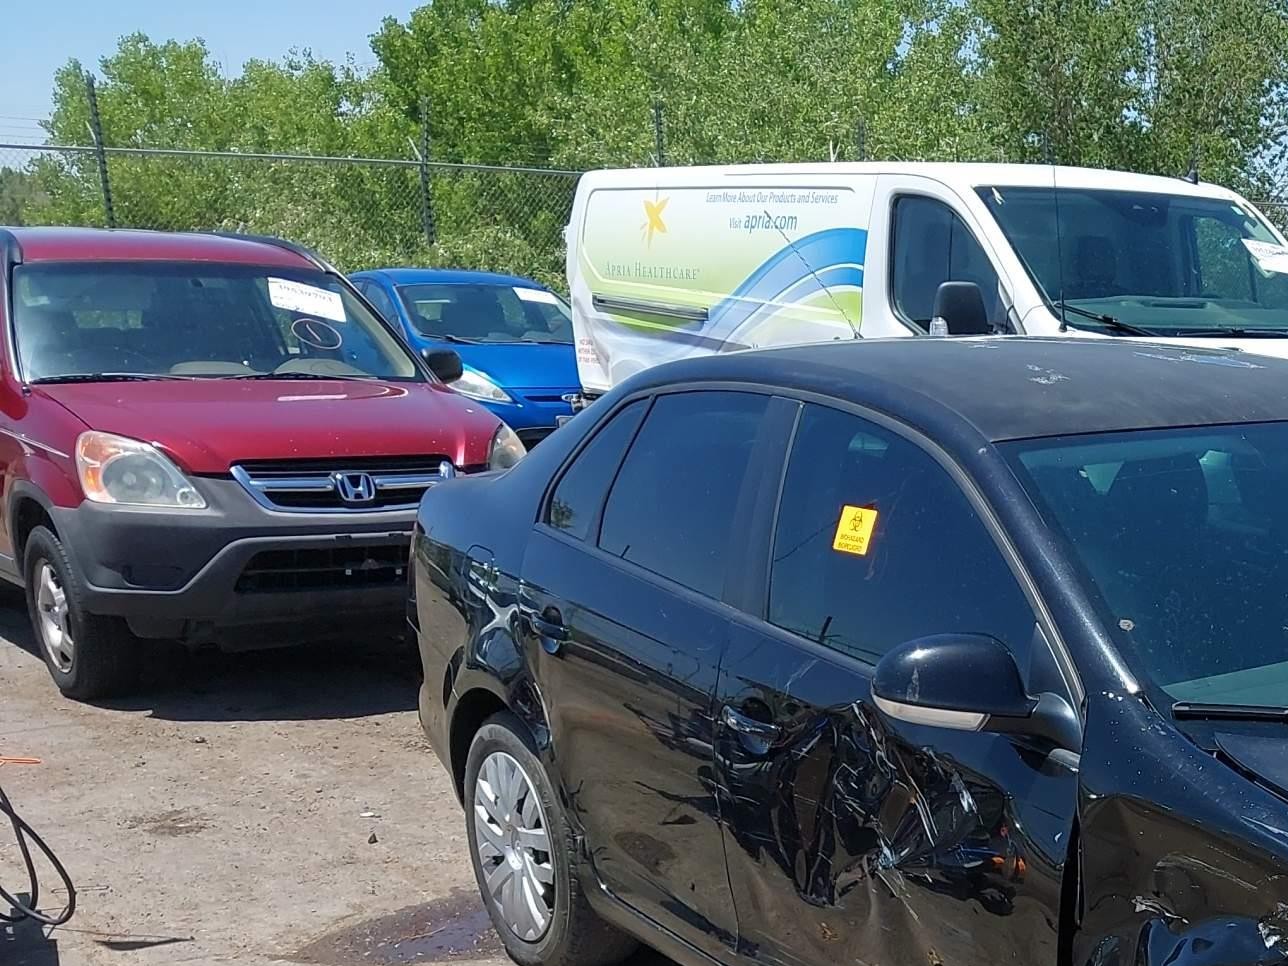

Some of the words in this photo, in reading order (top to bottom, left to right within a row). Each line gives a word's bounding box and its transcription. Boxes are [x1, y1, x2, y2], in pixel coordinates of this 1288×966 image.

[706, 191, 722, 203] Learn
[722, 191, 737, 203] More
[738, 191, 756, 203] About
[757, 191, 769, 203] Our
[769, 191, 797, 204] Products
[797, 191, 811, 204] and
[811, 191, 840, 205] Services
[743, 214, 798, 234] apria.com
